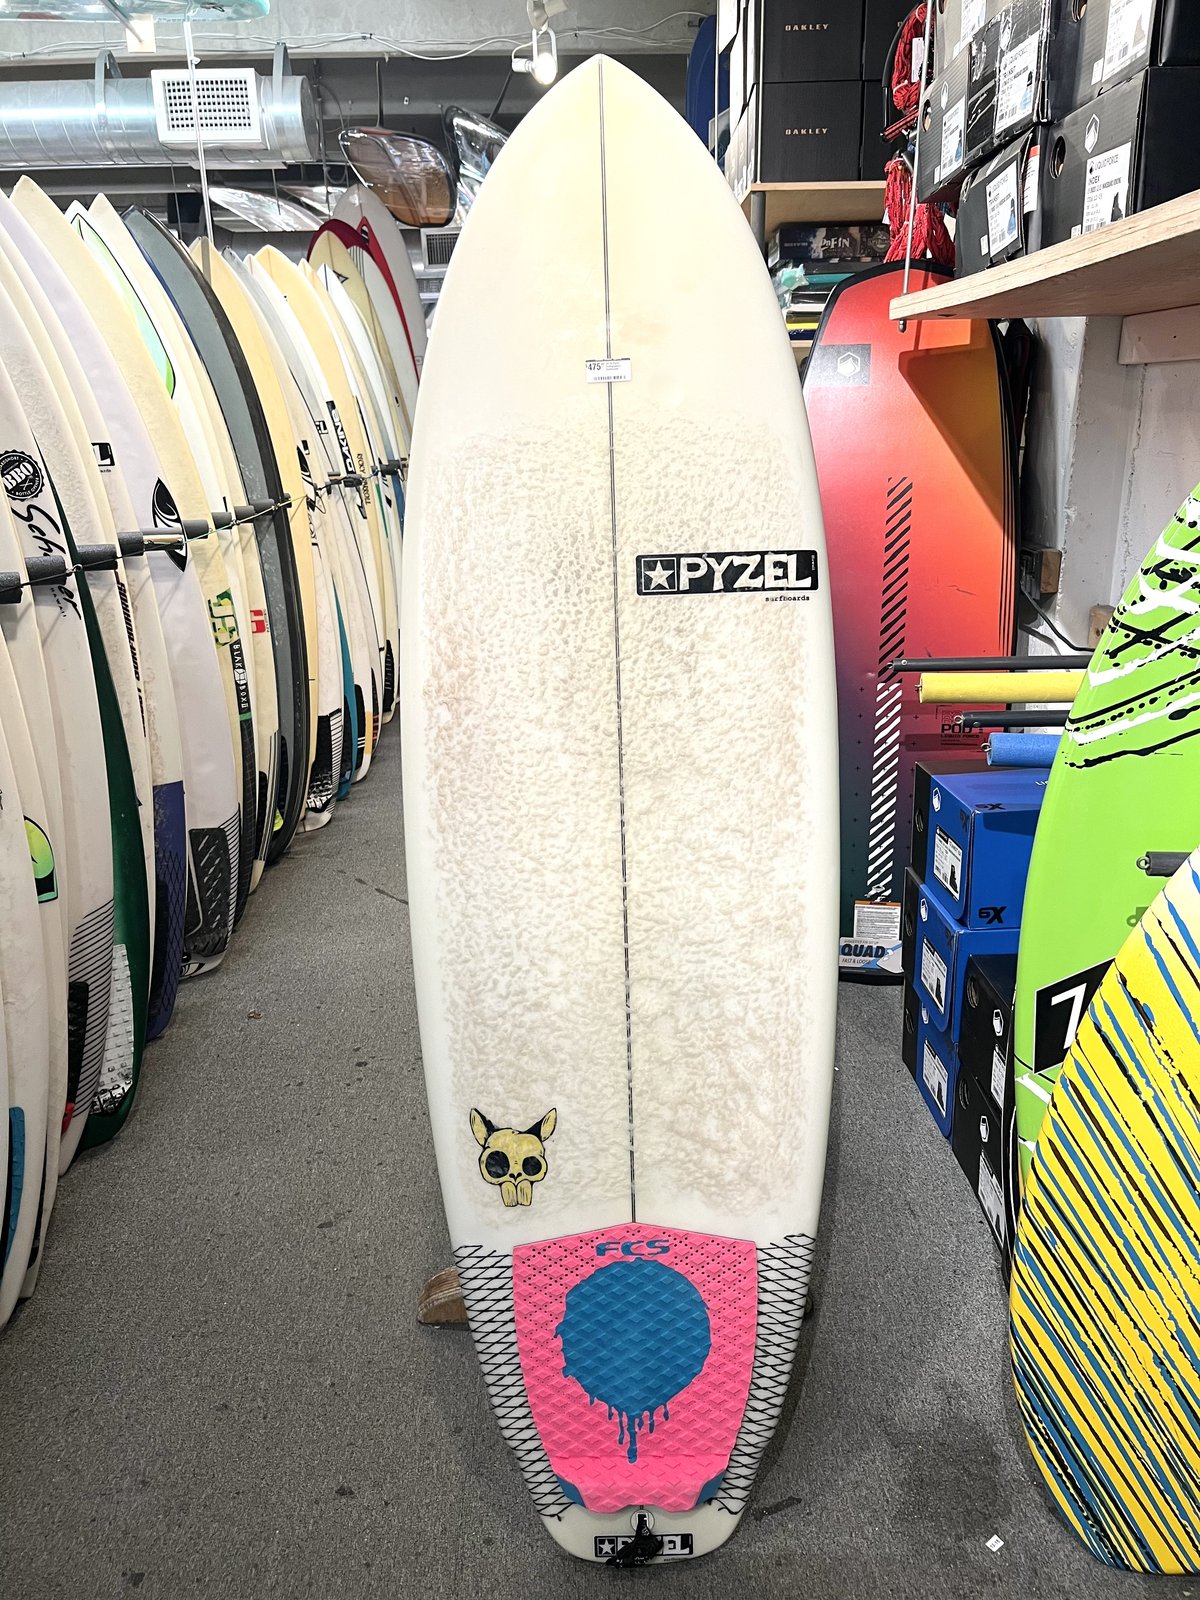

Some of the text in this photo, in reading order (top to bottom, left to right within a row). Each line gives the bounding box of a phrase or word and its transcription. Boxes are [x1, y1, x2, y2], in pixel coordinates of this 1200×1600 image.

[785, 23, 829, 32] OAKLEY
[785, 128, 828, 136] OAKLEY
[3, 462, 34, 490] BBO
[11, 504, 82, 620] Scher
[680, 553, 812, 591] PYZEL
[765, 594, 810, 602] surfboards
[232, 643, 244, 669] BLAK
[841, 944, 885, 957] QUAD
[596, 1239, 670, 1256] FCS
